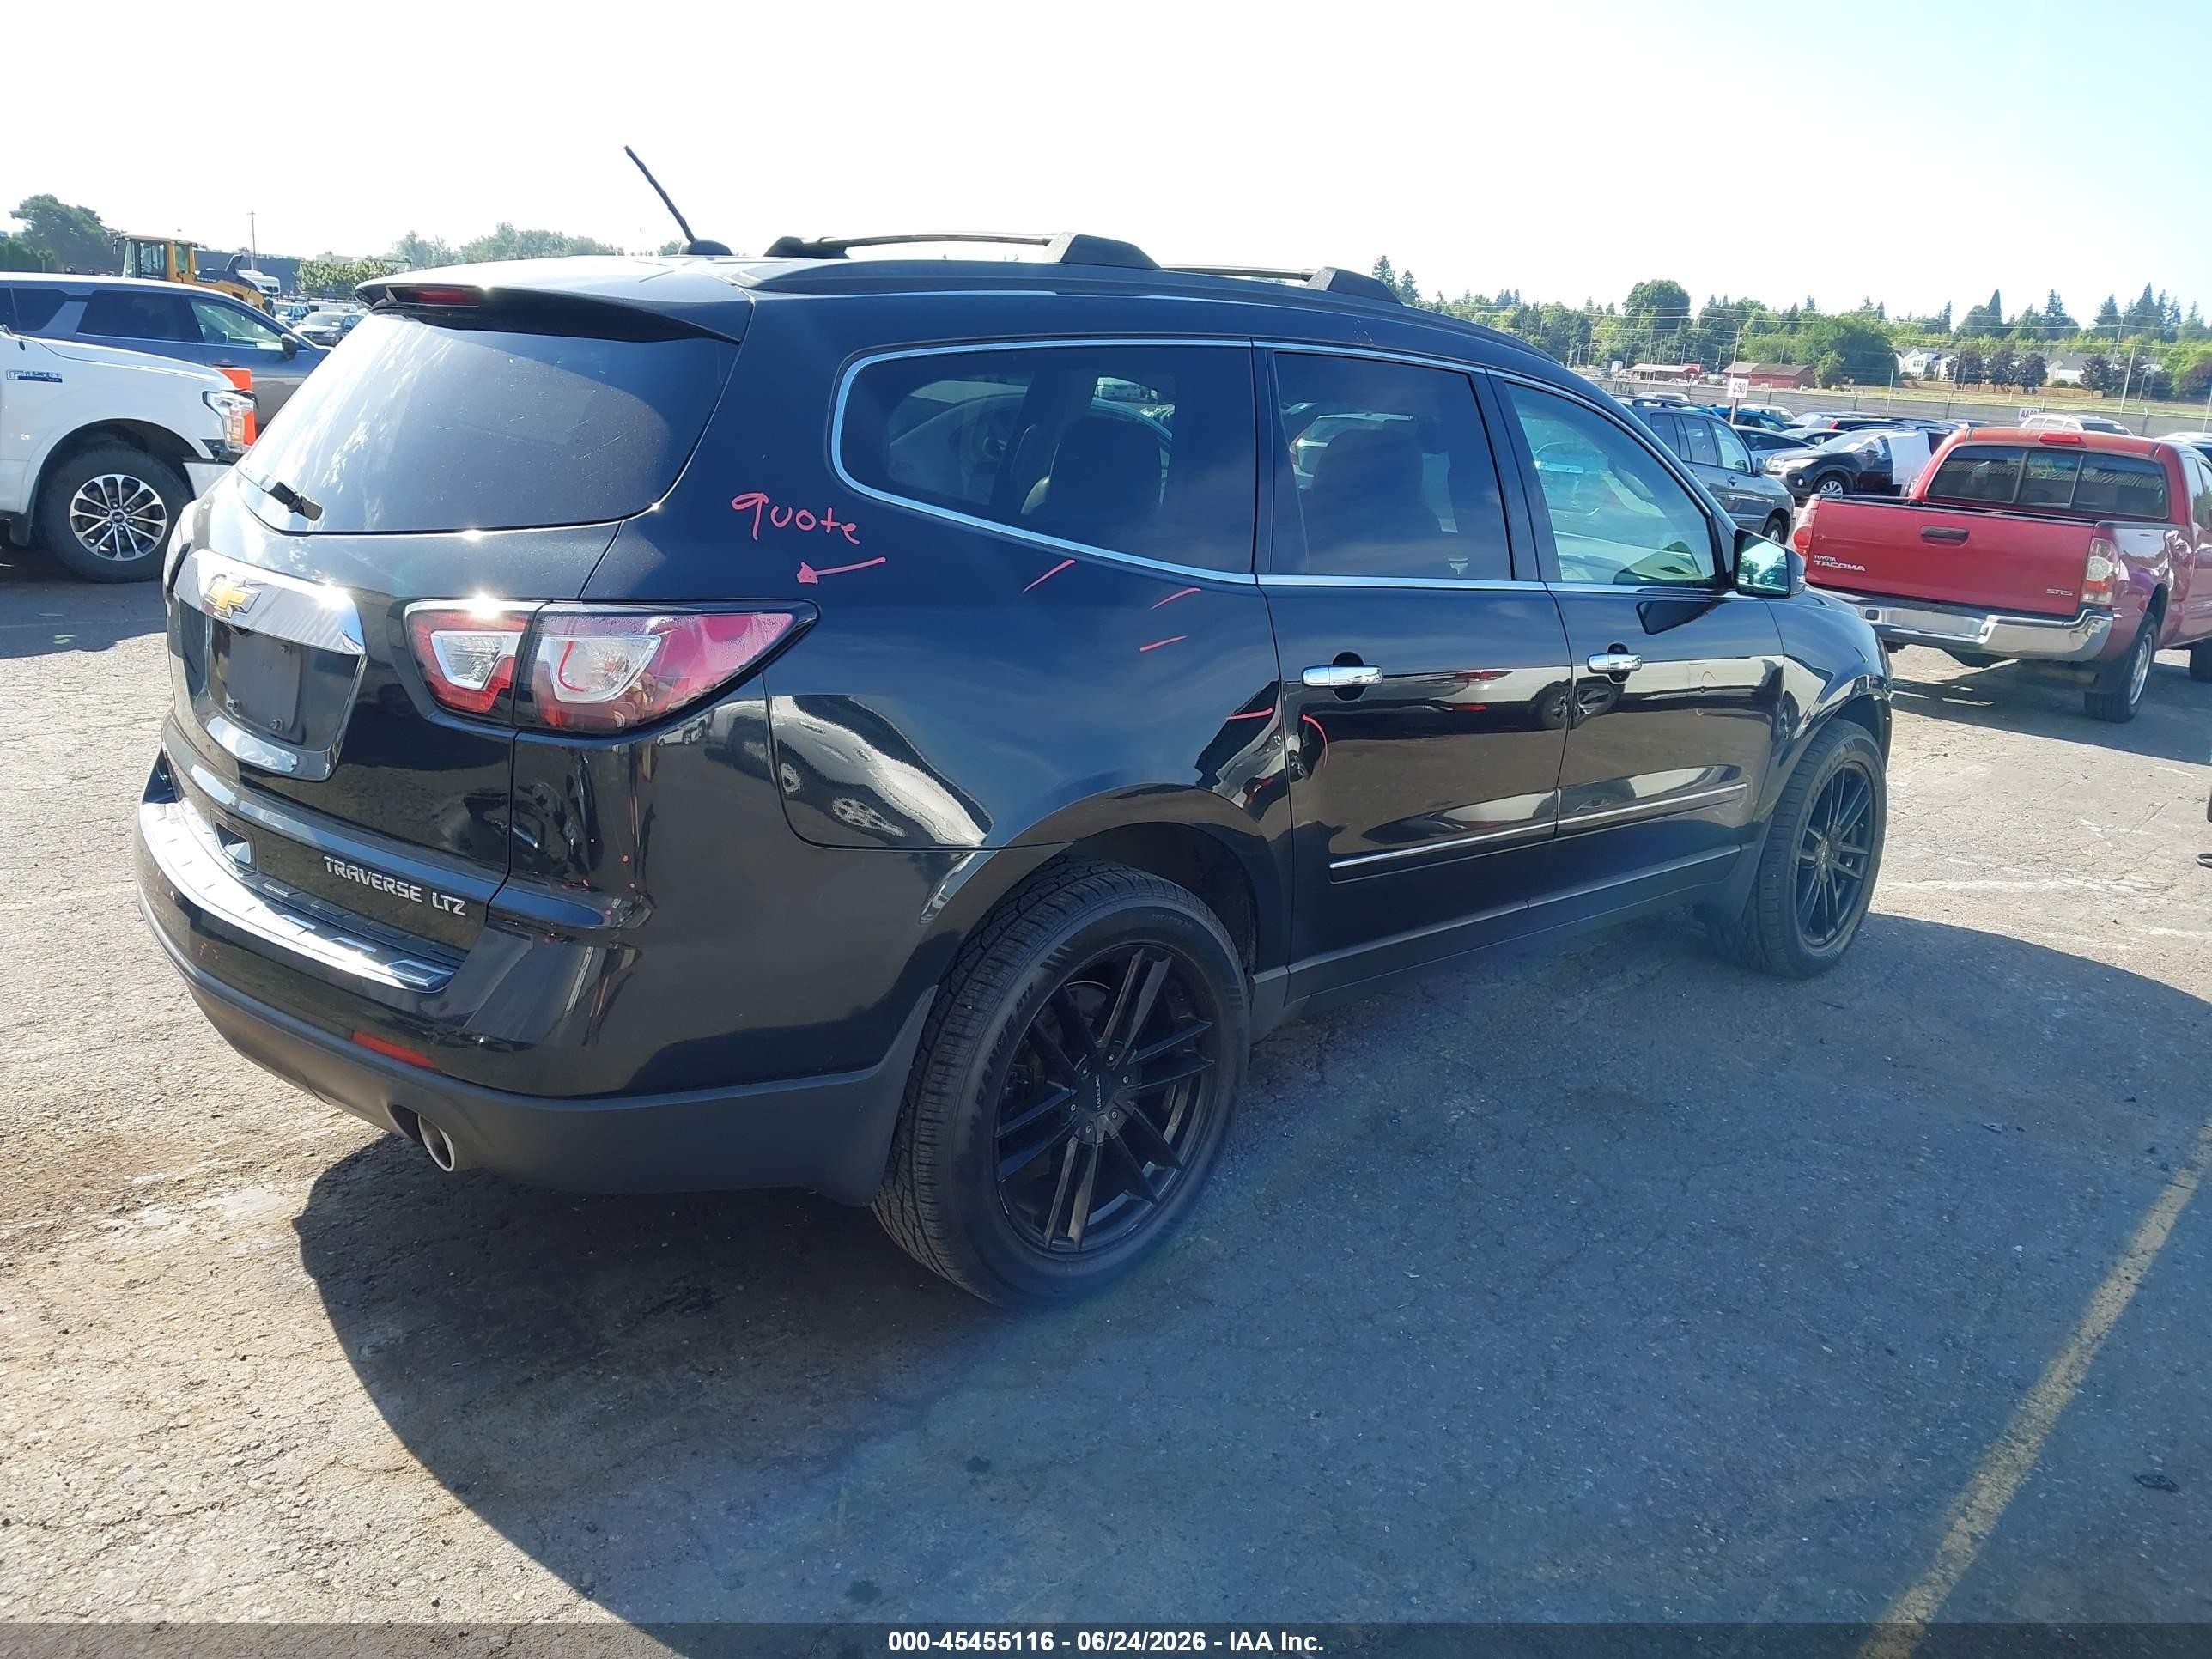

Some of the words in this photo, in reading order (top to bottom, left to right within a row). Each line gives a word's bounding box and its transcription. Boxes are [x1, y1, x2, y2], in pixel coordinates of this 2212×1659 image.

[732, 492, 860, 544] quote
[1813, 554, 1837, 562] TOYOTA
[1813, 560, 1866, 572] TACOMA
[323, 855, 423, 903] TRAVERSE
[432, 891, 467, 917] LTZ
